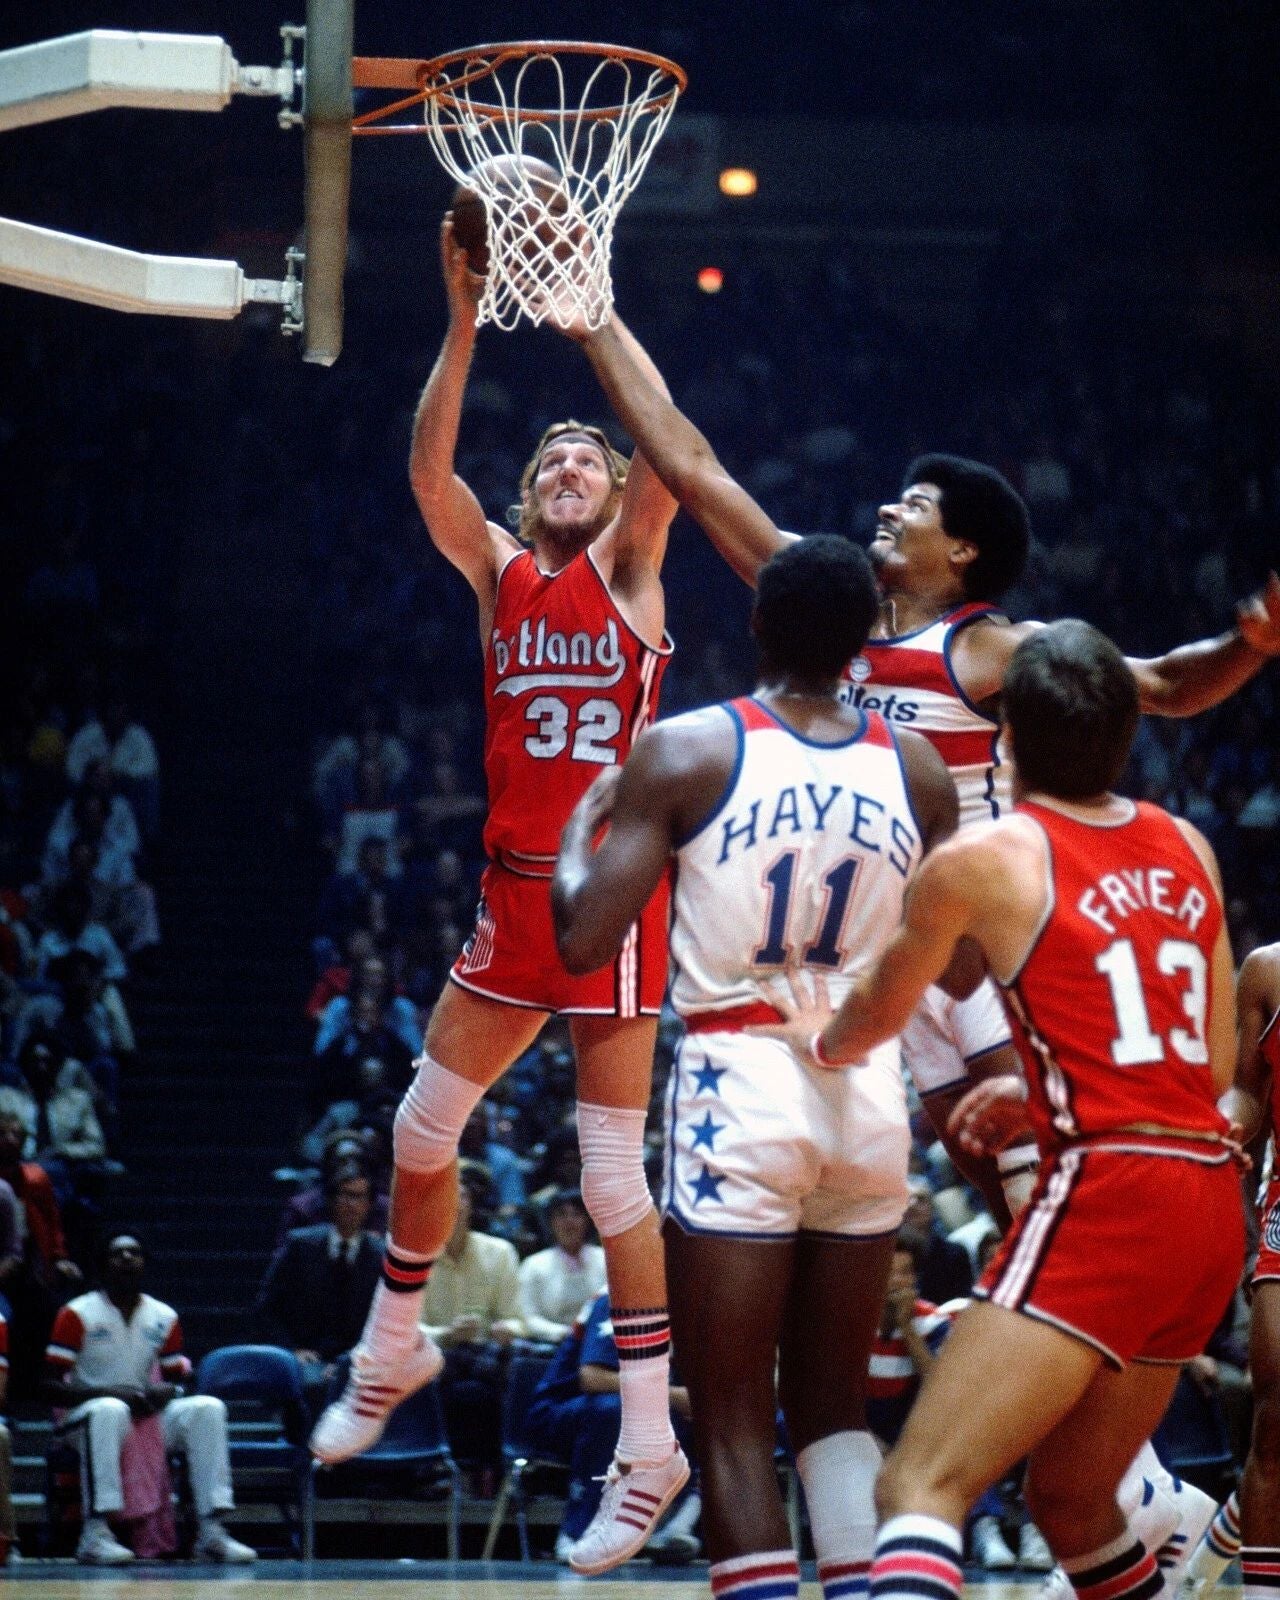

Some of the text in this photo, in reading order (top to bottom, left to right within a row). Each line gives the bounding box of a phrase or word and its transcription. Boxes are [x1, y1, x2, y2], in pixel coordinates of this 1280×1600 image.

[492, 616, 626, 675] otland
[524, 696, 622, 765] 32
[716, 782, 915, 879] HAYES
[753, 848, 863, 972] 11
[1077, 867, 1208, 935] FRYER
[1094, 938, 1210, 1066] 13
